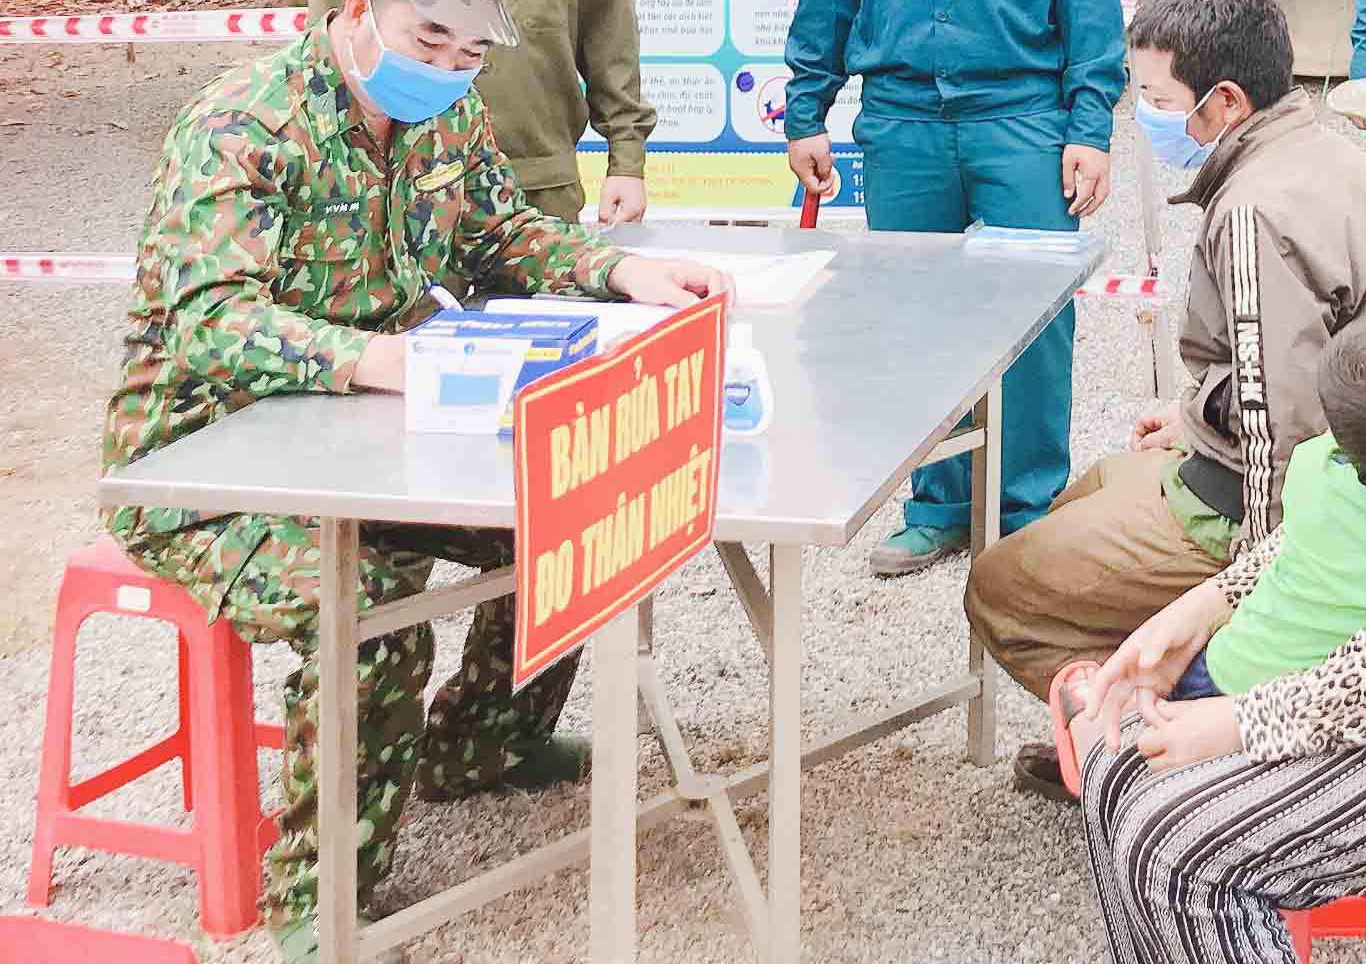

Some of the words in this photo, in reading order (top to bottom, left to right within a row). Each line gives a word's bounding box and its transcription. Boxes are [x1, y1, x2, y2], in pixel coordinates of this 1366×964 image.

[550, 402, 612, 500] BÀN
[614, 356, 660, 465] RỬA
[665, 348, 705, 431] TAY
[533, 540, 574, 628] ĐO
[581, 491, 648, 596] THÂN
[649, 444, 713, 551] NHIỆT
